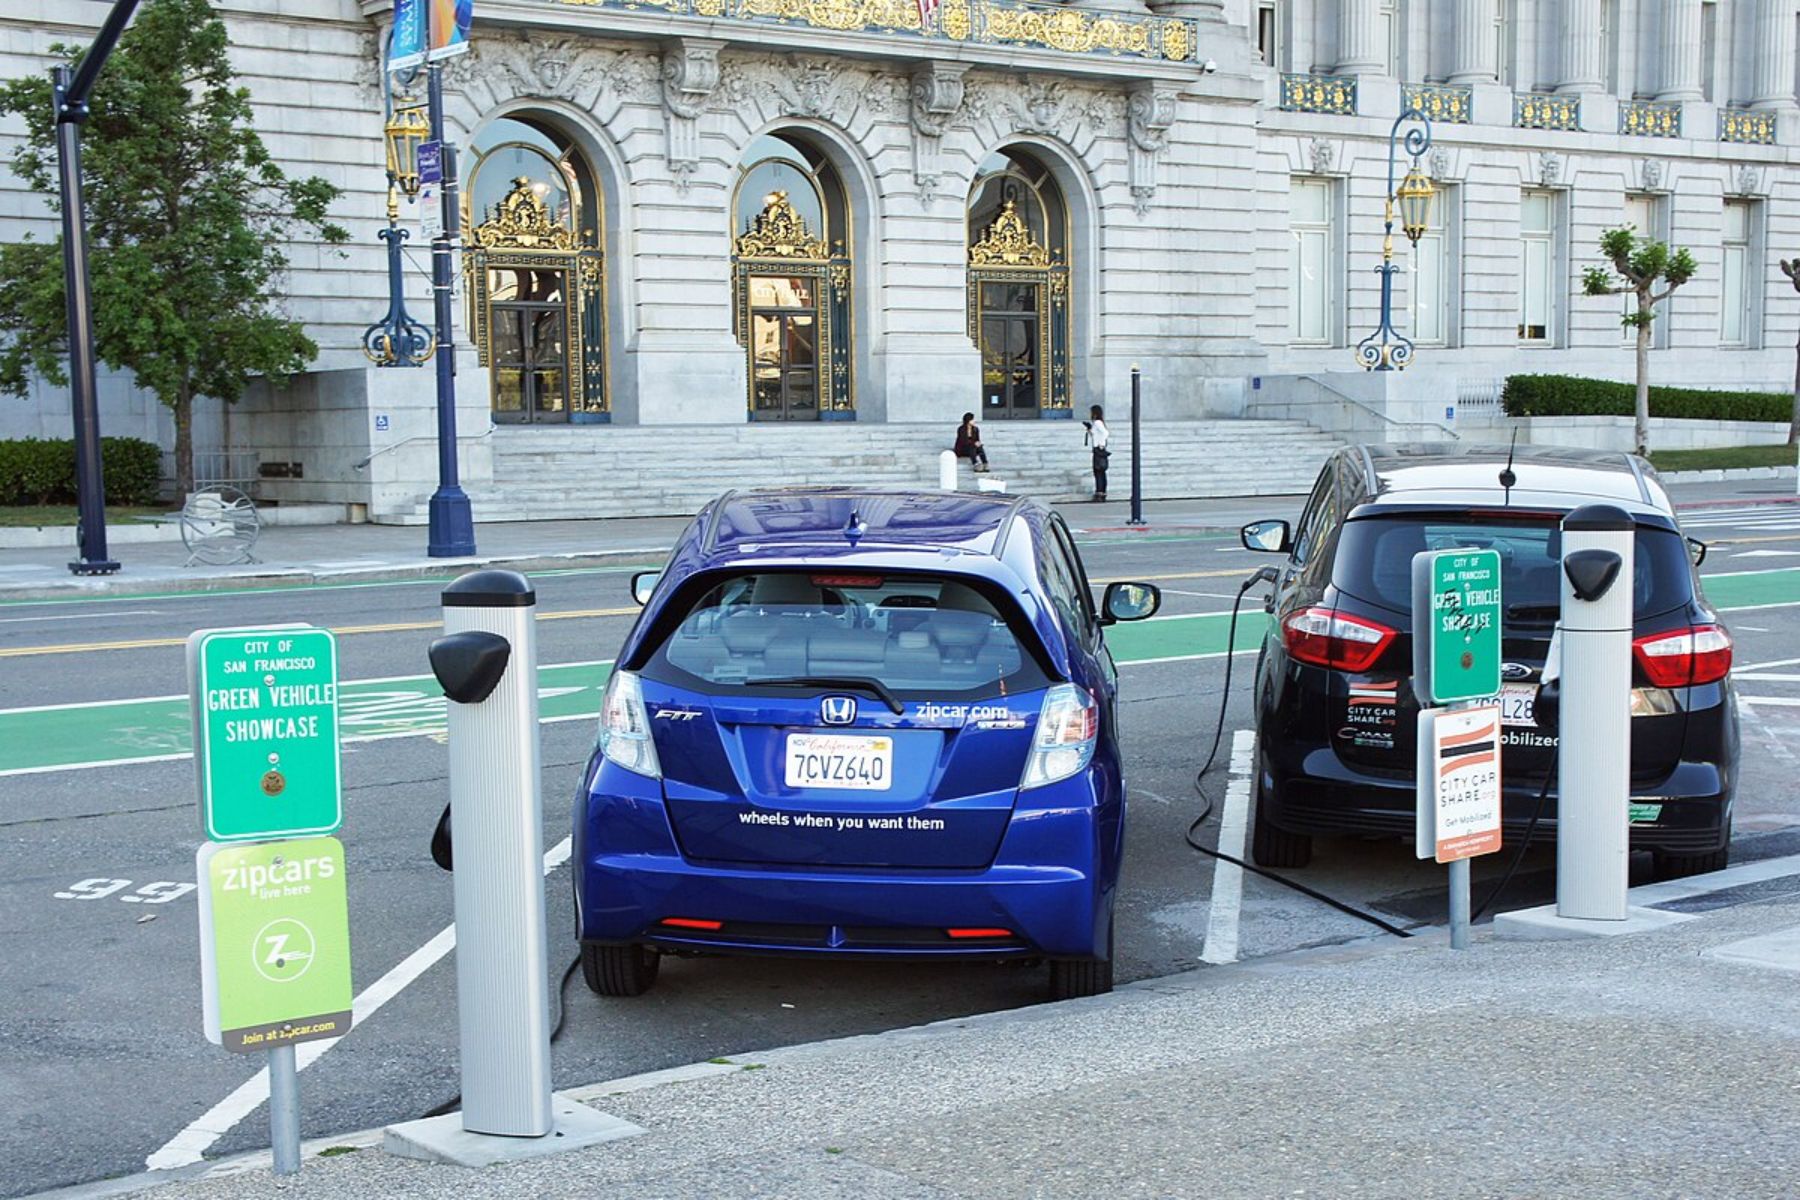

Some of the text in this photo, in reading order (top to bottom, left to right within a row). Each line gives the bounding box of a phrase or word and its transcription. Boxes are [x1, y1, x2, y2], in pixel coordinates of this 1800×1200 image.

[1453, 557, 1467, 568] CITY
[1442, 572, 1456, 582] SAN
[1465, 589, 1500, 606] VEHICLE
[244, 640, 293, 654] CITY OF
[223, 657, 316, 673] SAN FRANCISCO
[208, 684, 335, 712] GREEN VEHICLE
[915, 701, 1009, 722] zipcar.com
[1347, 706, 1396, 717] CITY CAR
[225, 716, 319, 742] SHOWCASE
[1499, 731, 1559, 747] obilize
[794, 754, 884, 781] 7CVZ640
[1440, 771, 1496, 793] CITY CAR
[739, 811, 945, 831] wheels when you want them
[221, 855, 336, 896] zipcars
[259, 883, 312, 900] live here
[241, 1022, 336, 1045] Join at zpcar.com
